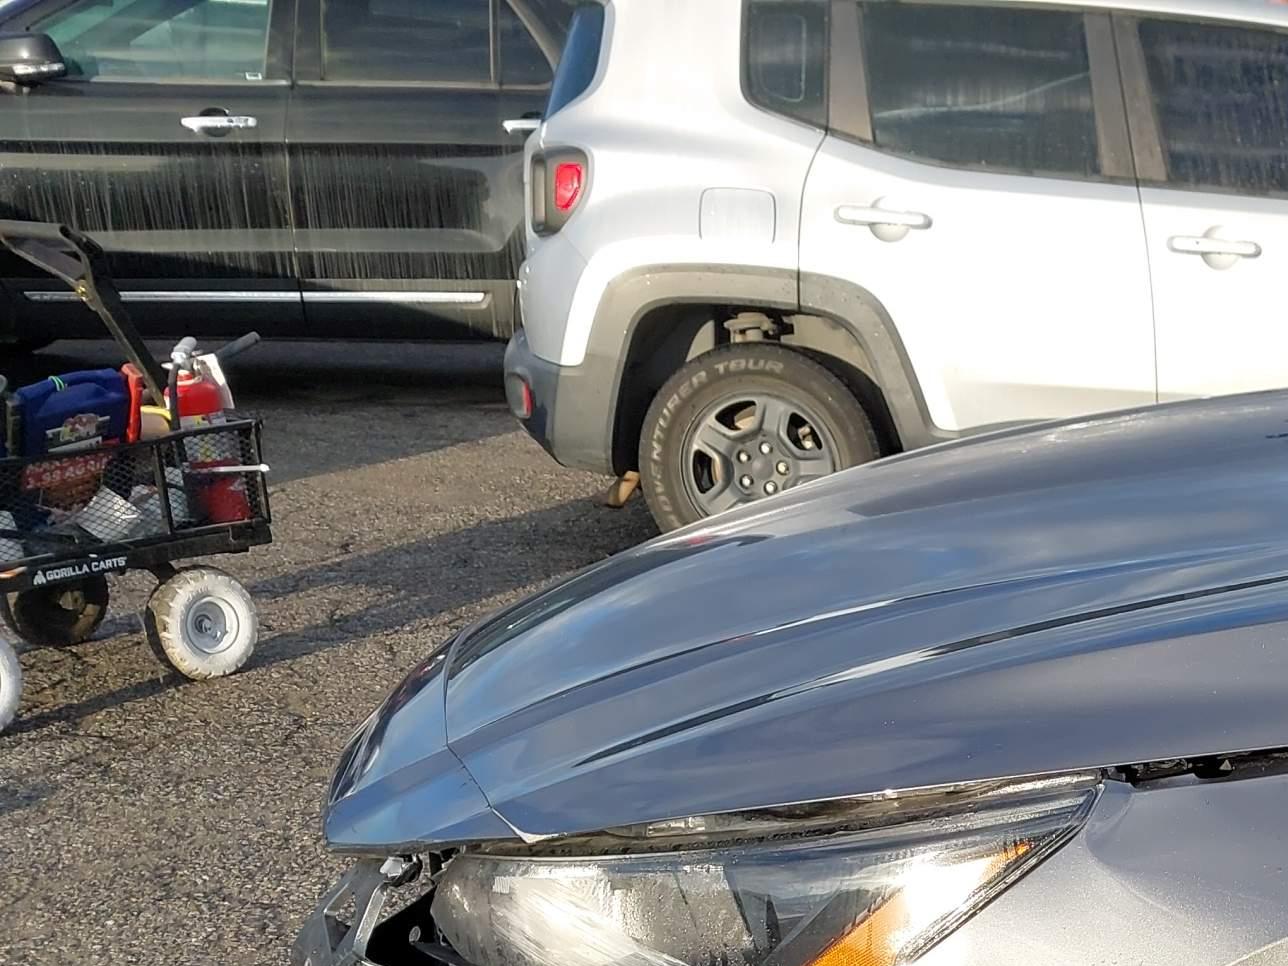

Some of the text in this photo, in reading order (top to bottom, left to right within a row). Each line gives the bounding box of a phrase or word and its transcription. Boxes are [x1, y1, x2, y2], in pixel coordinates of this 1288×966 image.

[714, 358, 784, 375] TOUR
[46, 557, 126, 580] GORILLA CARTS
